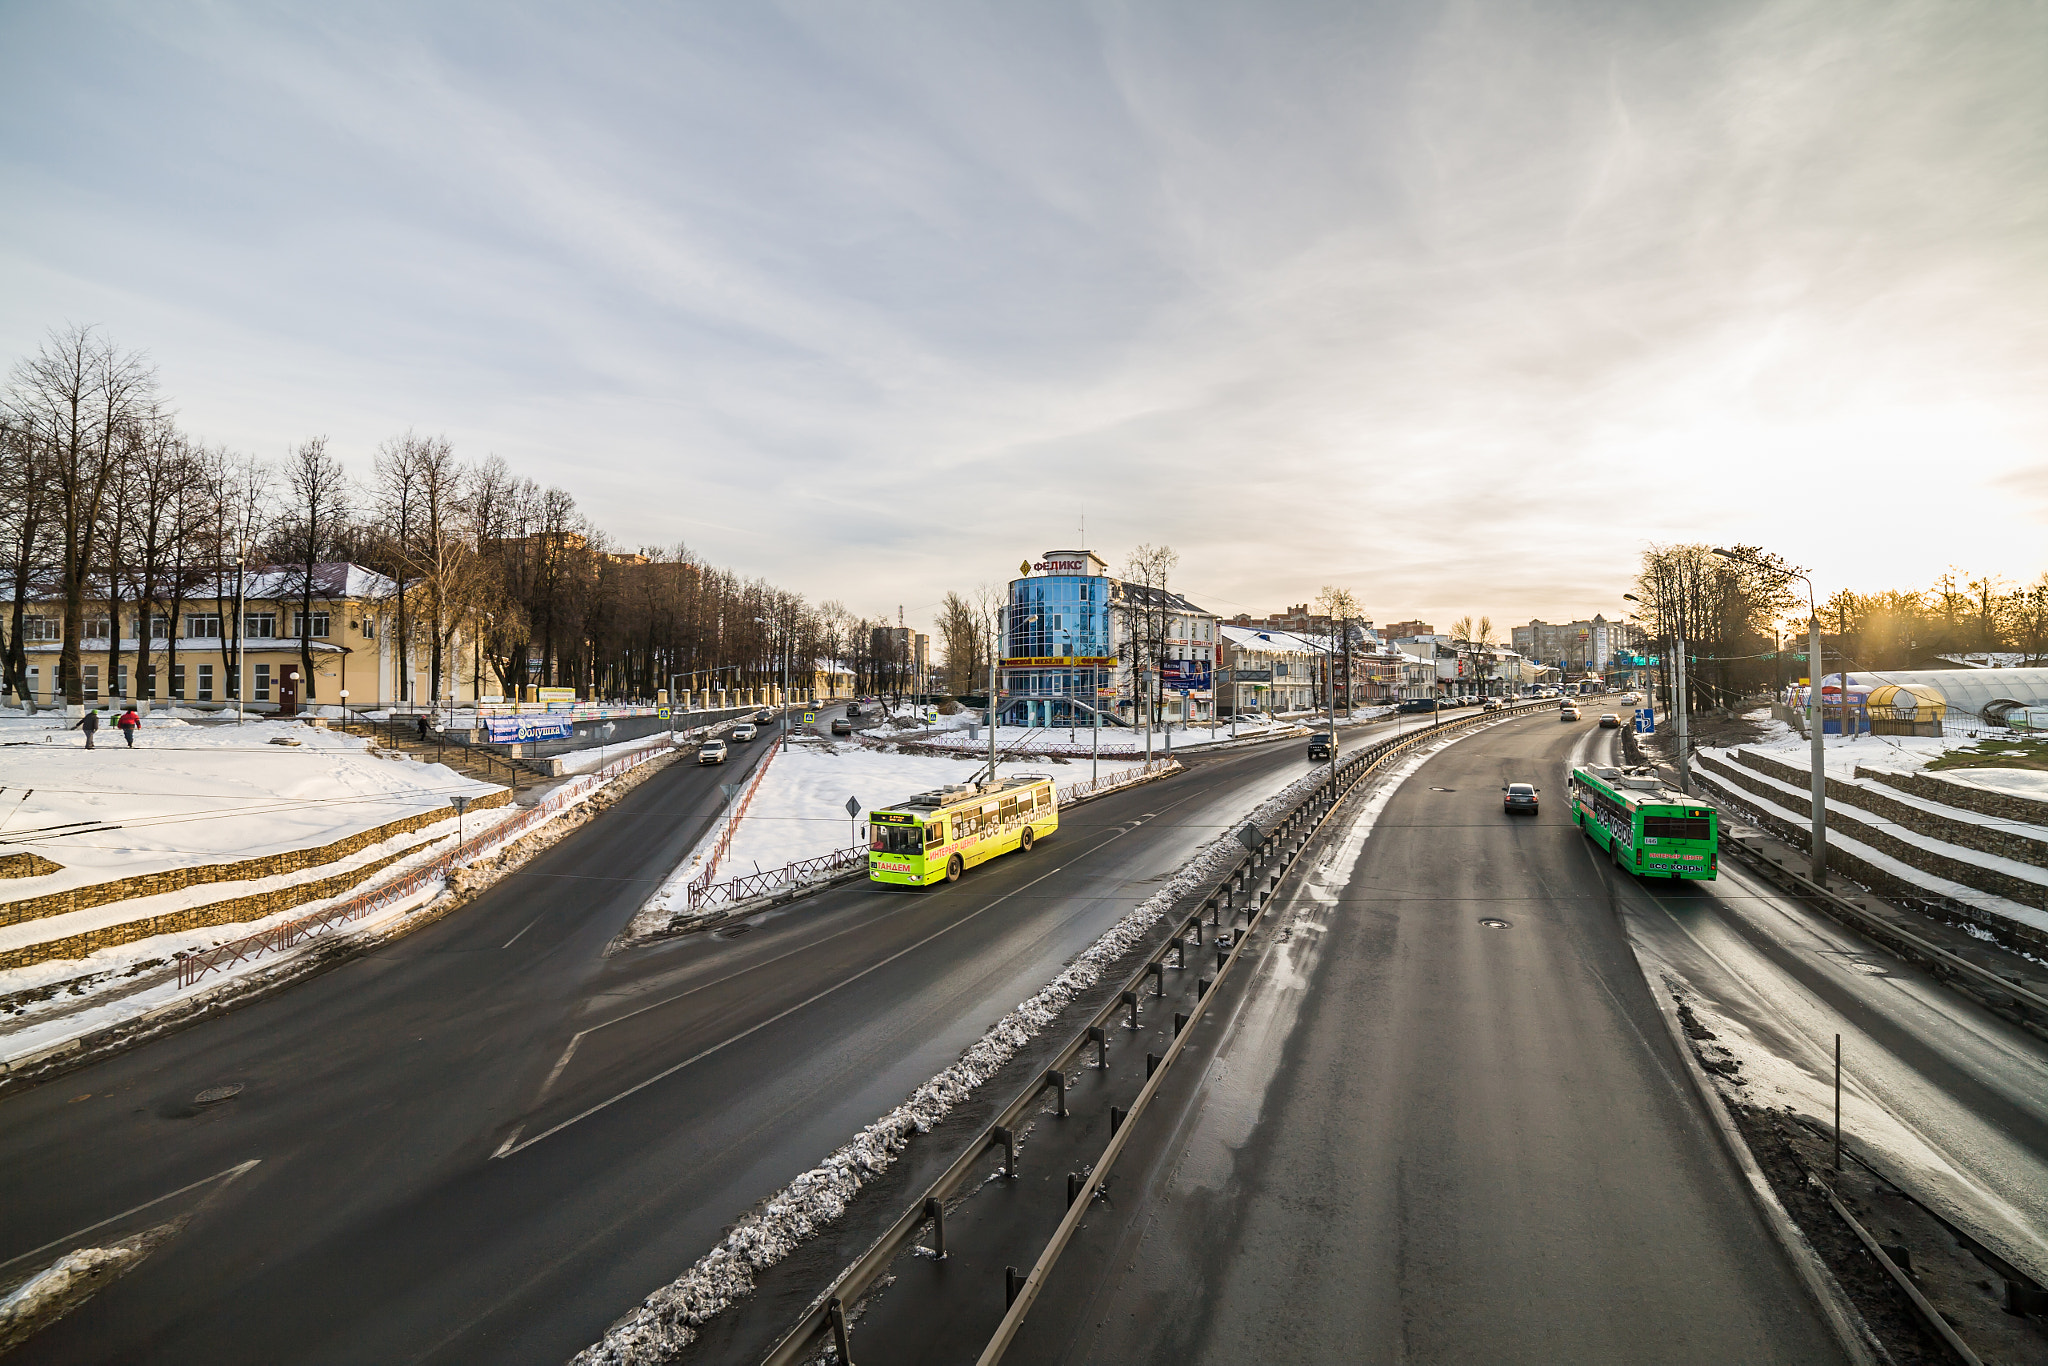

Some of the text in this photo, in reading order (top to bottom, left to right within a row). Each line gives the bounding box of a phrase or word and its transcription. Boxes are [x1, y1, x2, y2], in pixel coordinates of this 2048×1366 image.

[1034, 560, 1082, 571] ФЕЛИКС
[517, 719, 561, 740] Золушка
[1004, 812, 1022, 835] для
[1596, 804, 1608, 830] все
[1609, 814, 1634, 851] ковры
[929, 836, 977, 862] ИНТЕРЬЕР ЦЕНТР
[877, 861, 911, 872] ТАНДЕМ
[1670, 864, 1703, 873] ковры
